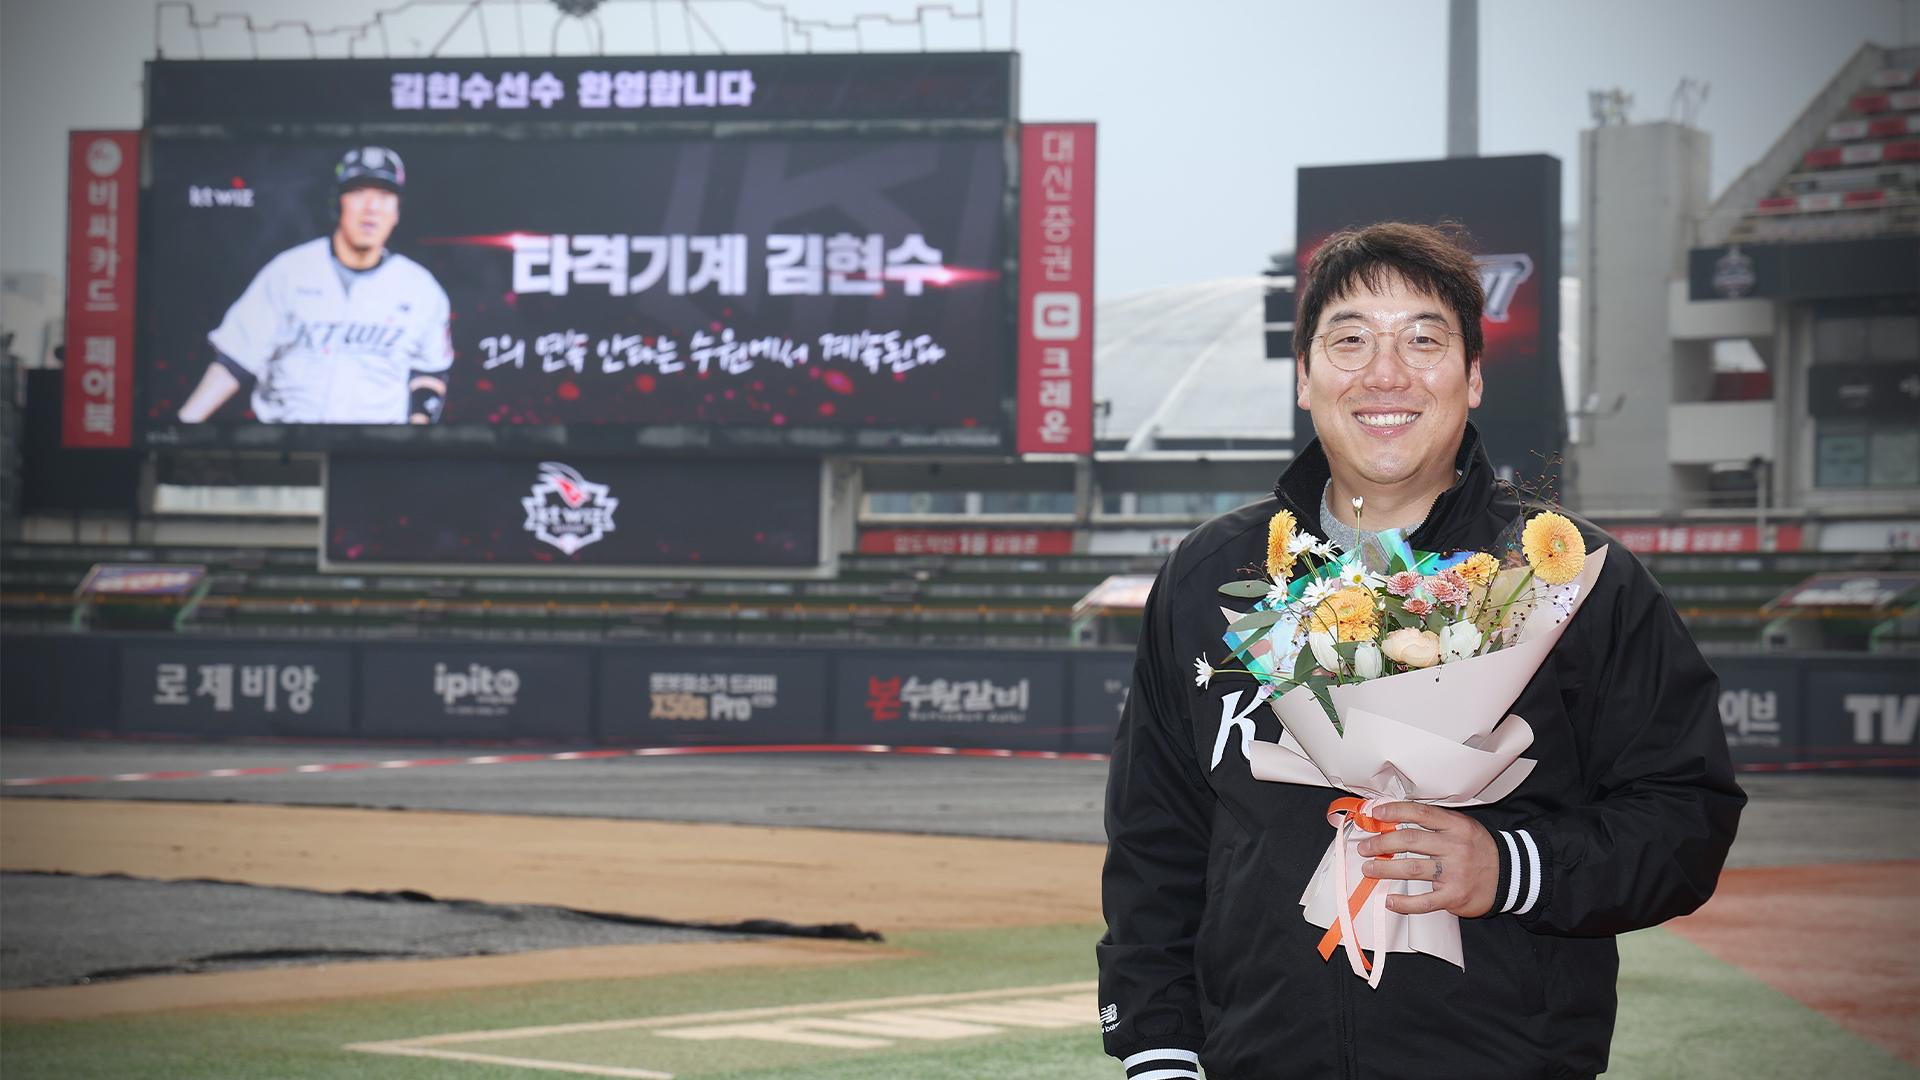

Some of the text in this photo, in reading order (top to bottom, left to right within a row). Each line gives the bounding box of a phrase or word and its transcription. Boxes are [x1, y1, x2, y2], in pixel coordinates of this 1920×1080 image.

[391, 69, 754, 110] 김현수선수 환영합니다
[1041, 131, 1074, 281] 대신증권
[85, 180, 118, 312] 비씨카드
[512, 233, 944, 296] 타격기계 김현수
[690, 328, 809, 375] 수원에서
[82, 337, 116, 435] 페이북
[1038, 348, 1072, 445] 크레온
[155, 664, 318, 713] 로제비앙
[711, 692, 751, 720] Pro
